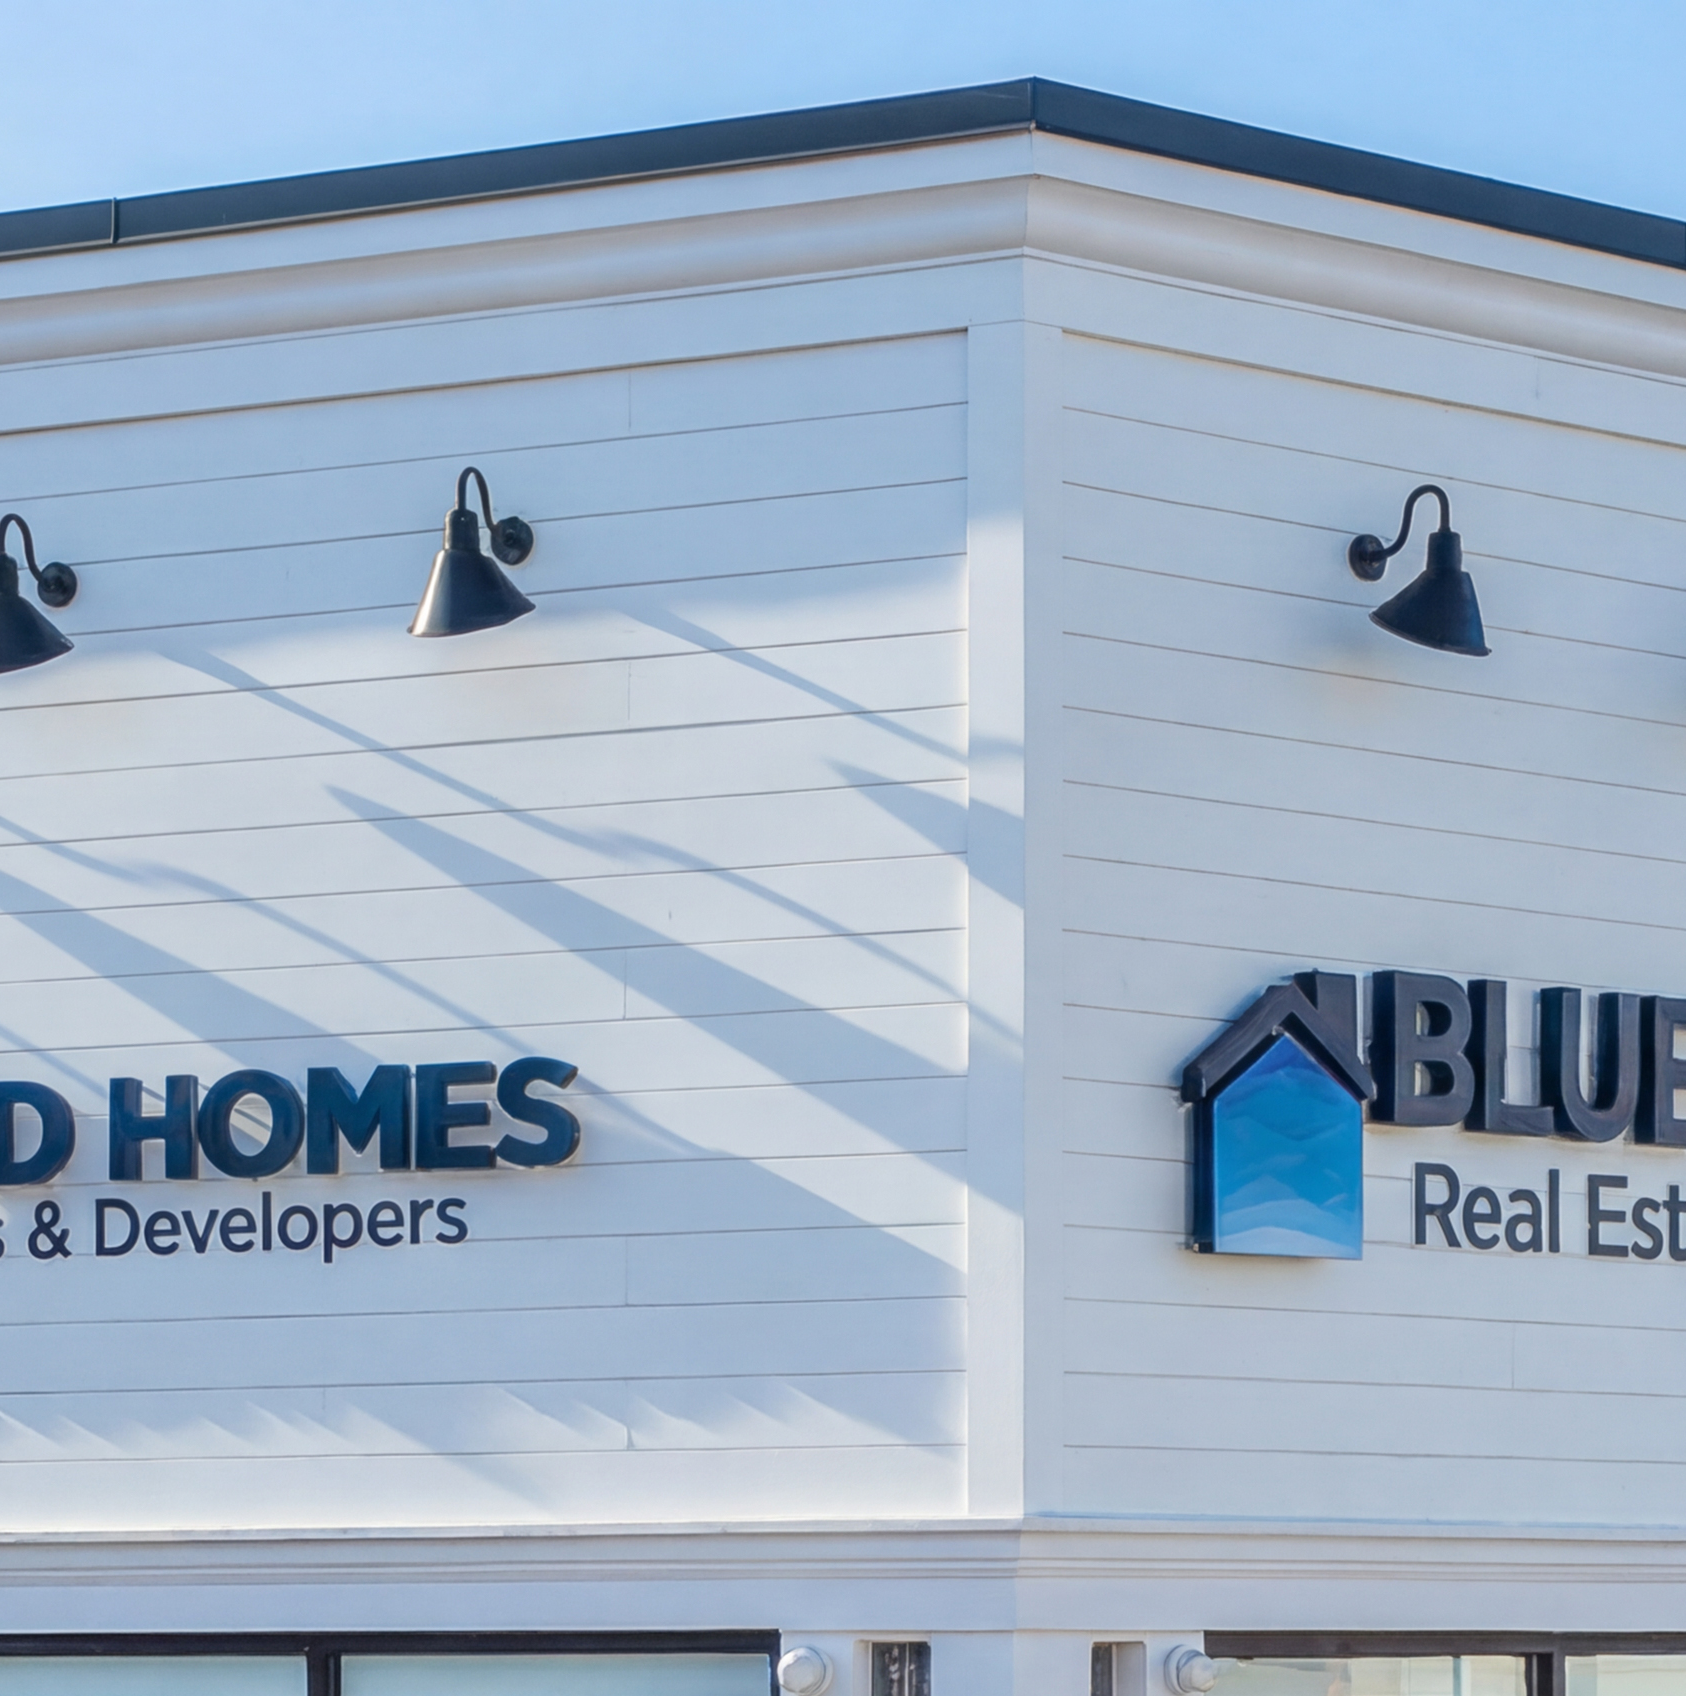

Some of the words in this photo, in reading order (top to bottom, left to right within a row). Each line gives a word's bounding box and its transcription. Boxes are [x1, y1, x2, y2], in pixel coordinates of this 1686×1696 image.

[108, 1056, 582, 1183] HOMES
[26, 1200, 73, 1261] &
[94, 1191, 469, 1264] Developers
[1413, 1161, 1561, 1254] Real
